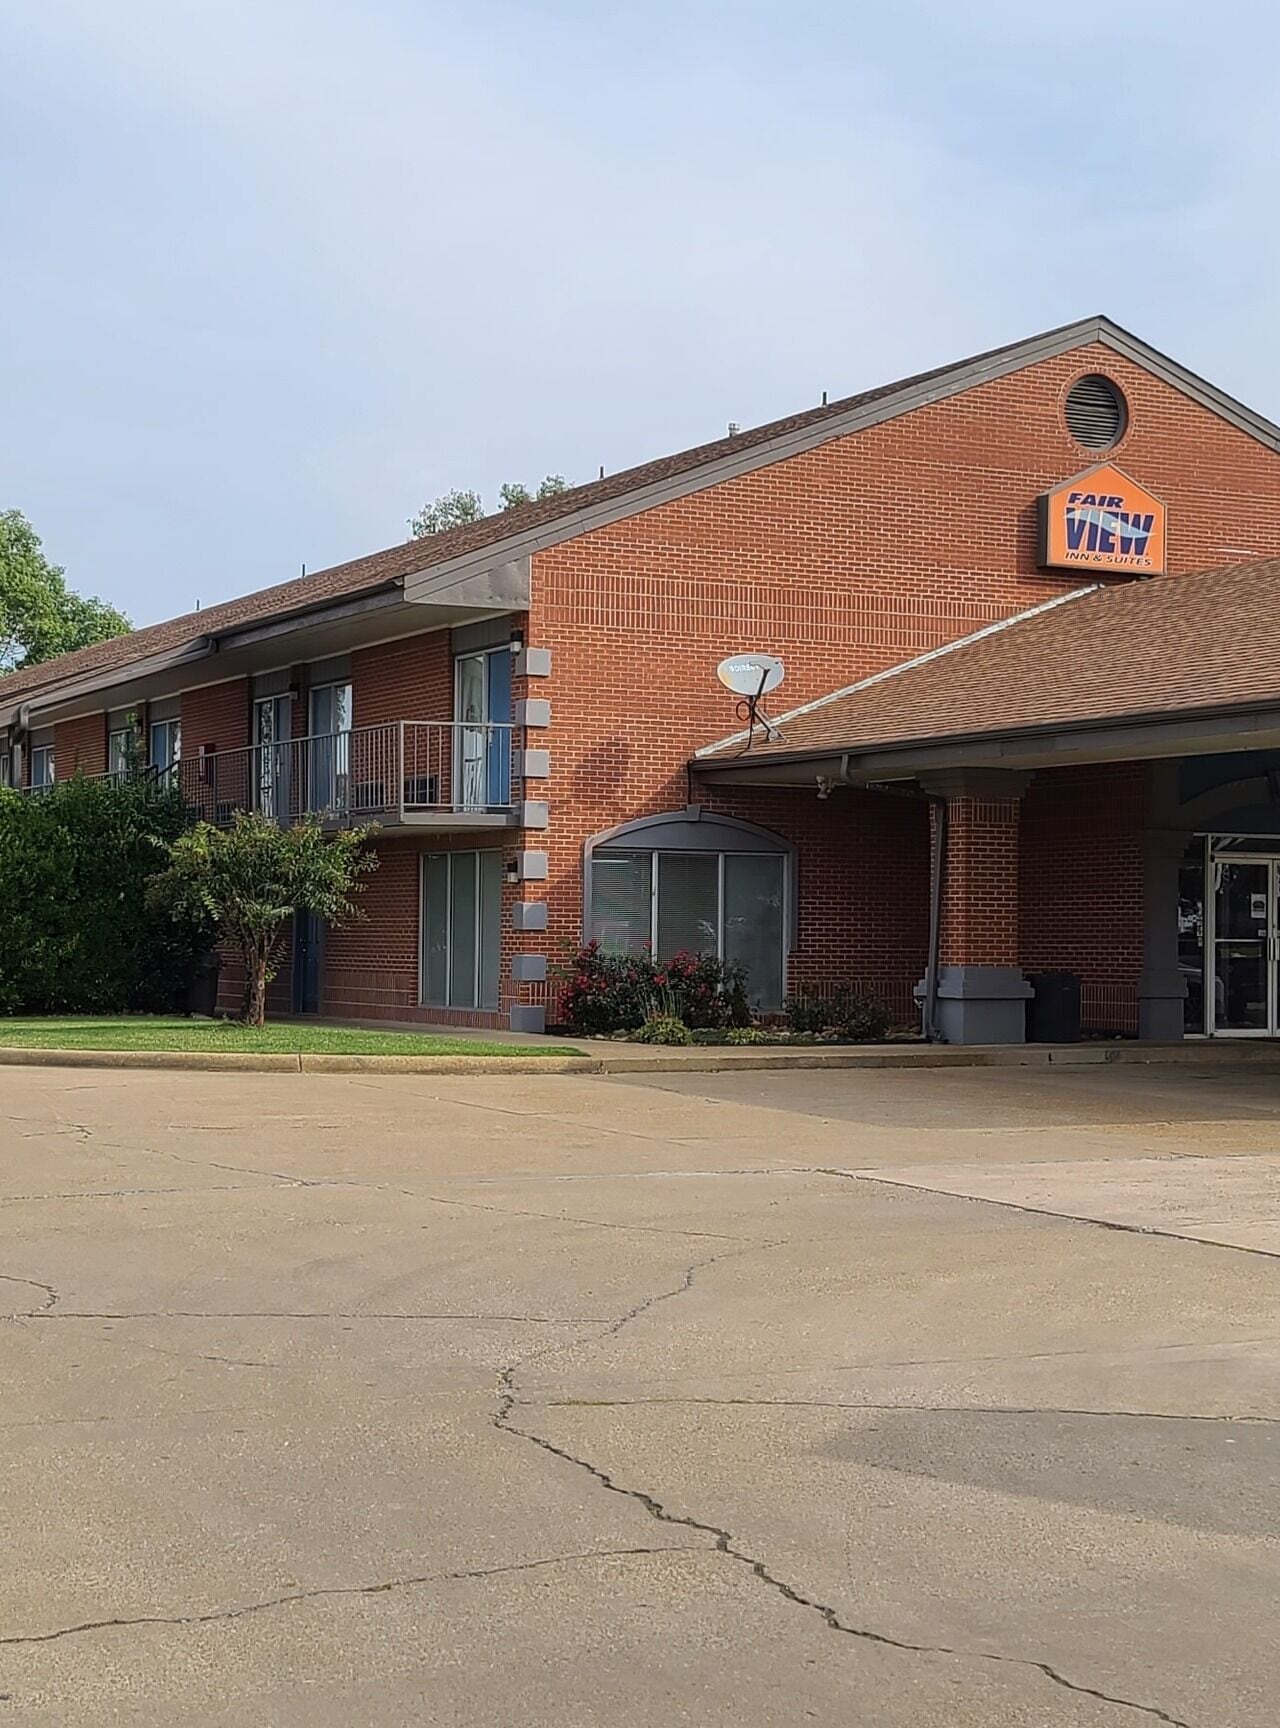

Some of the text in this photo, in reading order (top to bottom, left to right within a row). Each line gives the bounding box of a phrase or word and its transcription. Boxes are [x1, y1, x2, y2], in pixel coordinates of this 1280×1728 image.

[1068, 492, 1124, 509] FAIR
[1065, 507, 1154, 556] VIEW
[1065, 552, 1152, 566] INN & SUITES
